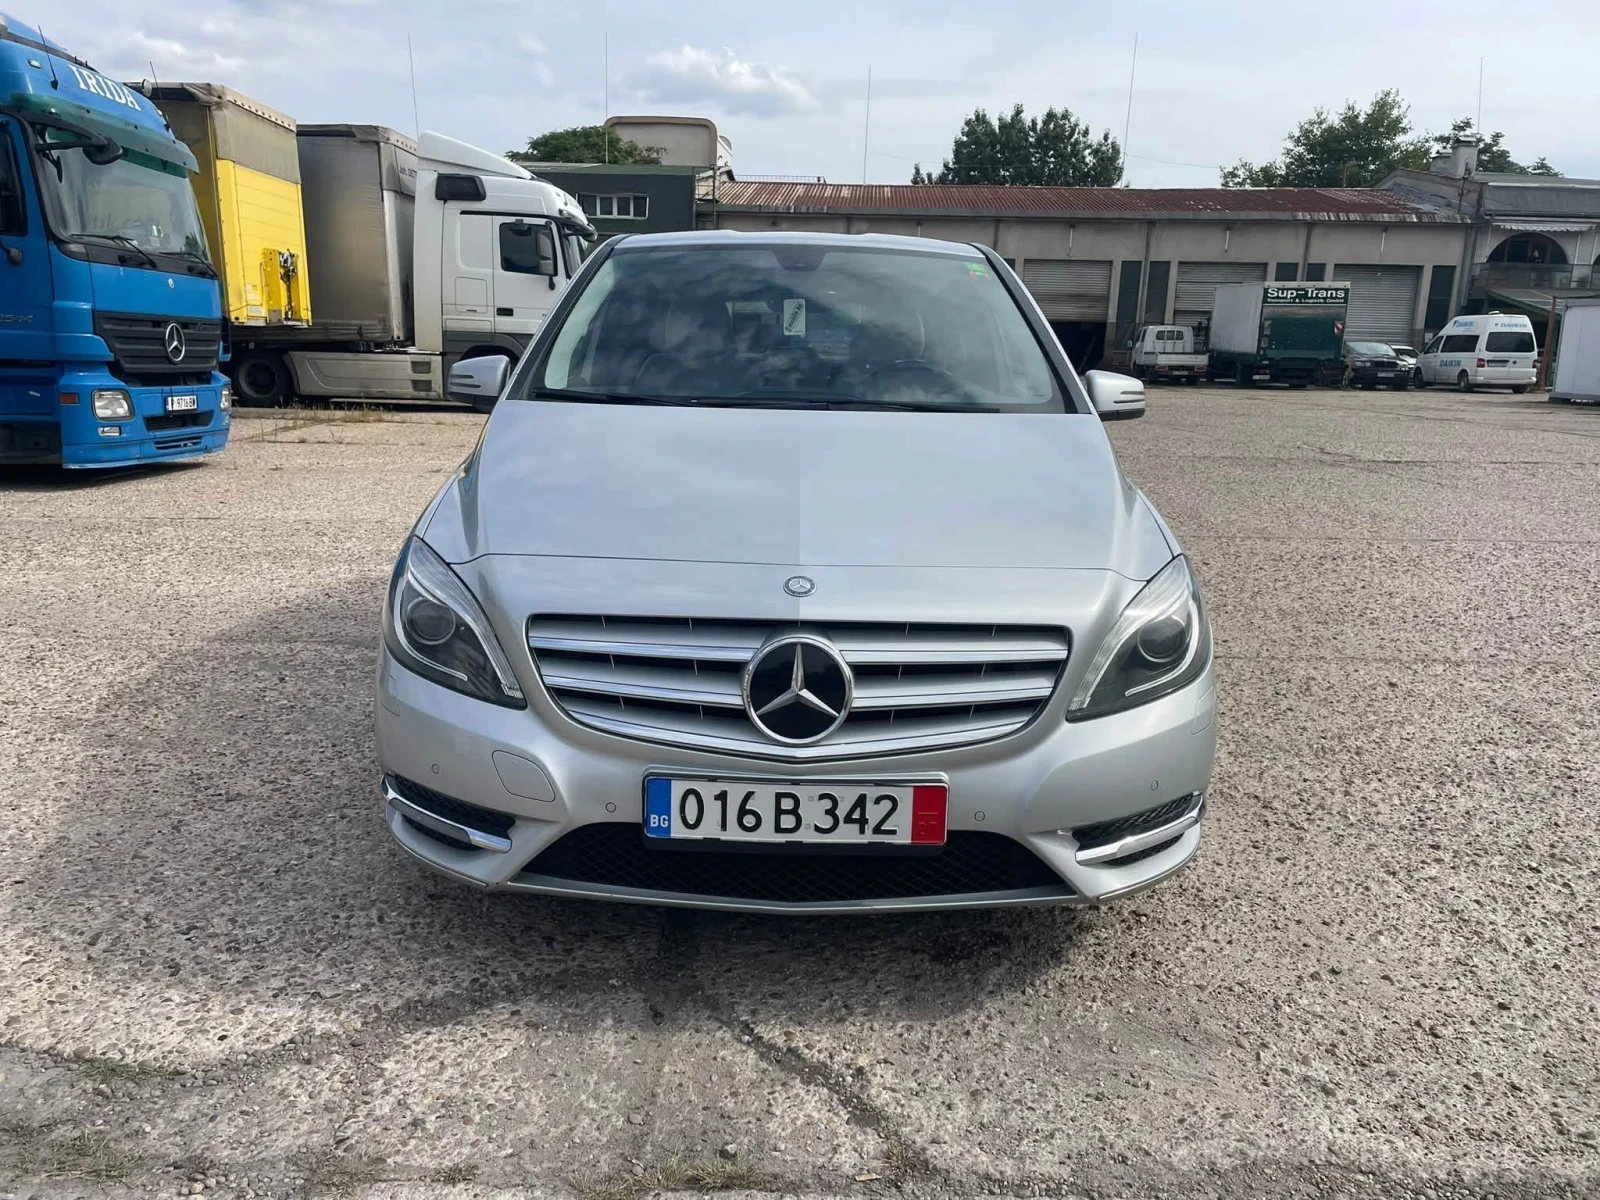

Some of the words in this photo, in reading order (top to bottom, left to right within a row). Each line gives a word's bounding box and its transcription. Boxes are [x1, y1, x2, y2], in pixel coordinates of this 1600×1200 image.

[68, 64, 142, 112] IRIDA
[1267, 288, 1345, 299] Sup-Trans
[1439, 359, 1462, 368] DAIKIN
[650, 814, 669, 828] BG
